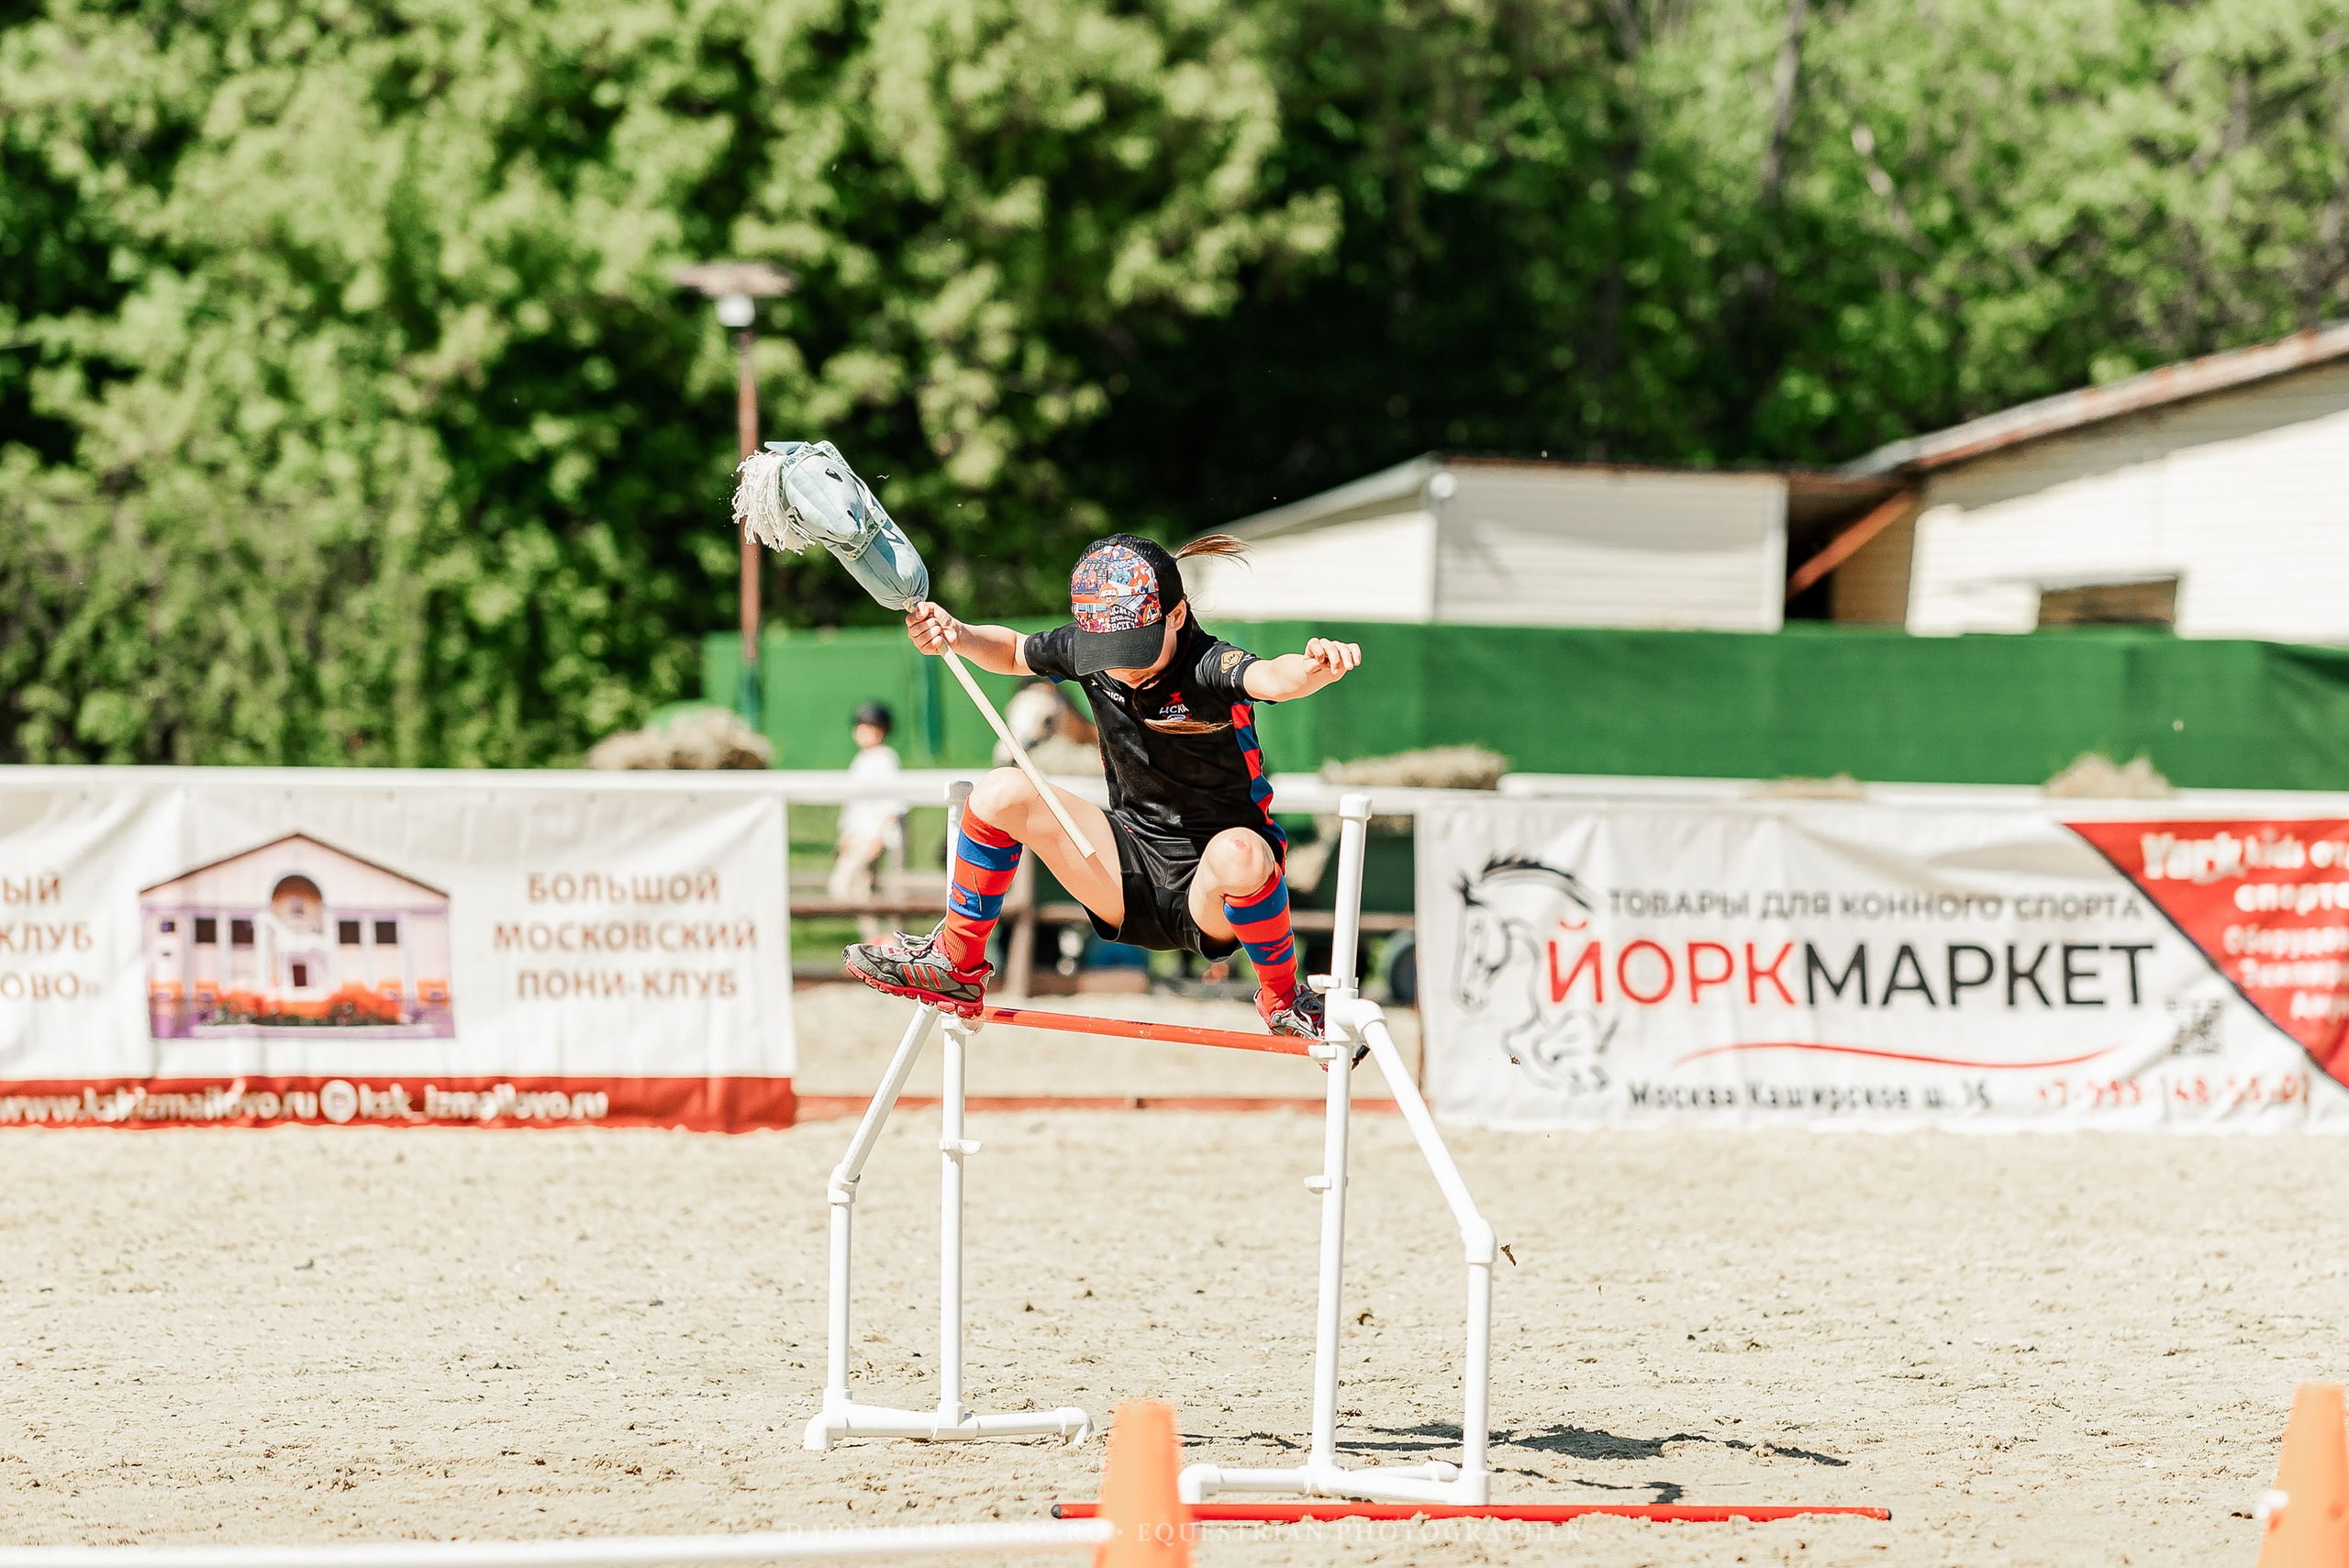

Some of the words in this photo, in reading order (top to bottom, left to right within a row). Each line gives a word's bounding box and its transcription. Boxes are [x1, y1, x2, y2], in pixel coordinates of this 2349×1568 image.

[1158, 703, 1190, 716] ЦСКА
[528, 865, 720, 905] БОЛЬШОЙ
[1608, 887, 1751, 919] ТОВАРЫ
[1760, 888, 1831, 921] ДЛЯ
[1841, 889, 2004, 921] КОННОГО
[2014, 892, 2144, 921] СПОРТА
[494, 914, 758, 954] МОСКОВСКИЙ
[517, 967, 738, 1001] ПОНИ-КЛУБ
[1627, 1080, 1736, 1110] Москва
